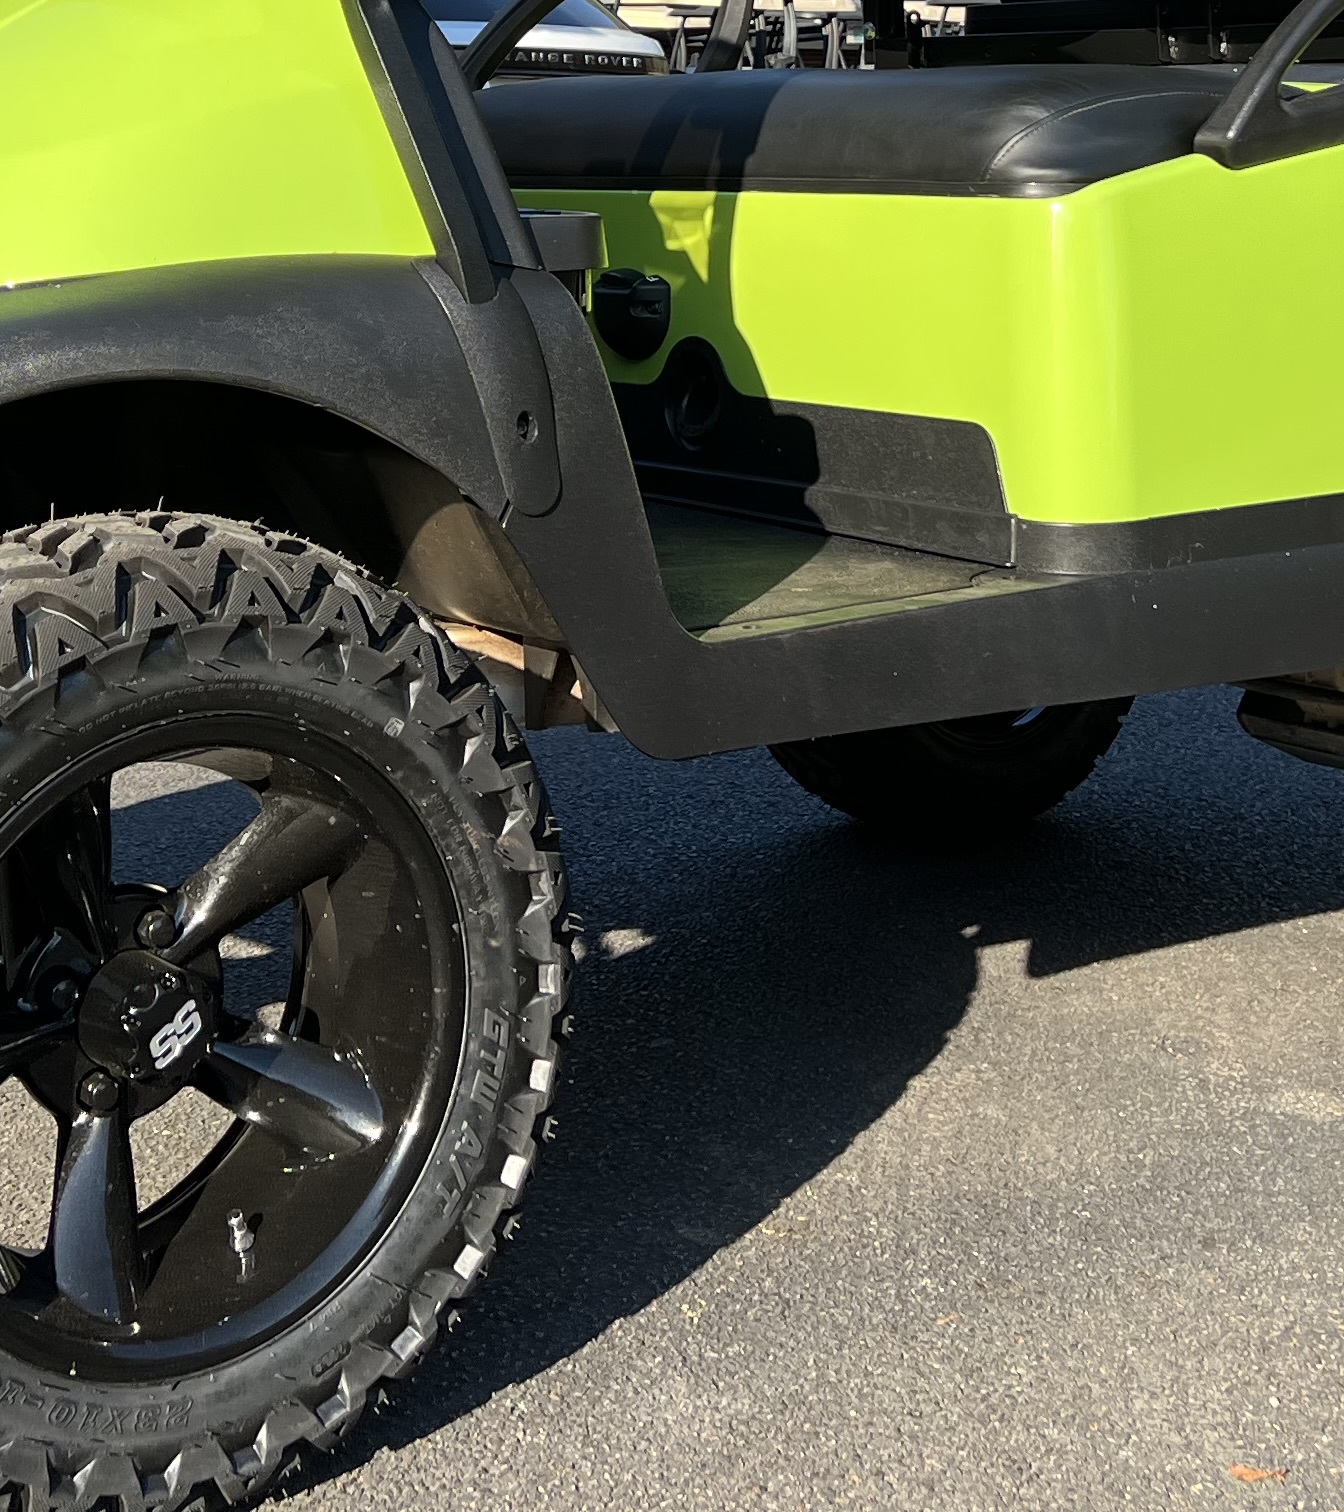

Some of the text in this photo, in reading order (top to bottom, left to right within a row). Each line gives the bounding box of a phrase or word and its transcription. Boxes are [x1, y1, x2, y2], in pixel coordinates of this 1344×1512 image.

[584, 54, 642, 68] ROVER
[150, 999, 202, 1069] SS
[436, 1007, 511, 1220] GTW A/T
